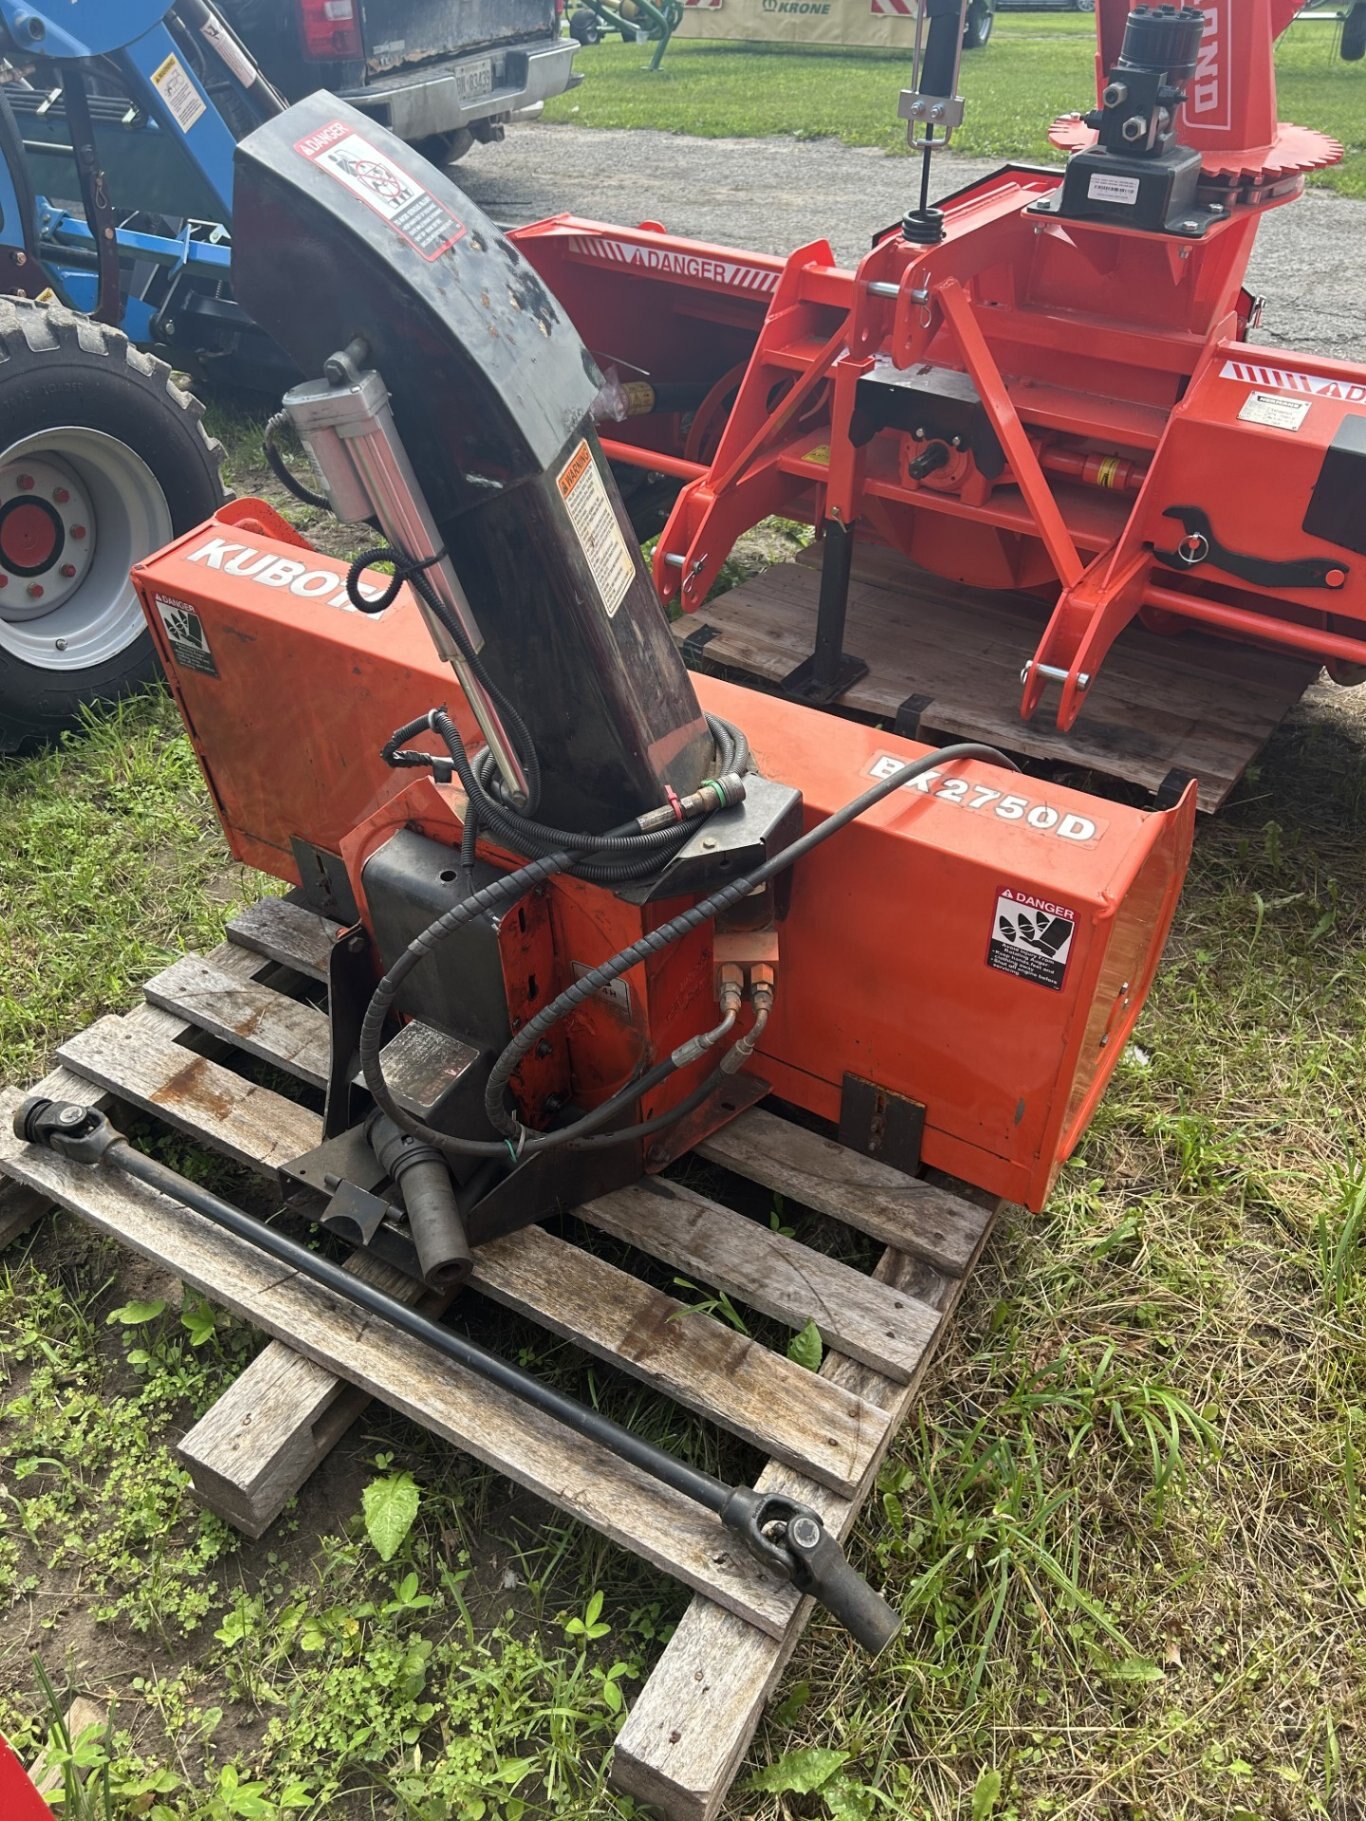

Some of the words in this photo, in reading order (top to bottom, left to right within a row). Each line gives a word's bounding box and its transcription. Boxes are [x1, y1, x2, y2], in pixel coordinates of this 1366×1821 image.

[779, 2, 830, 14] KRONE
[307, 122, 350, 152] DANGER
[648, 250, 726, 283] DANGER
[565, 446, 590, 488] WARNING
[161, 595, 196, 612] DANGER
[1016, 892, 1074, 919] DANGER
